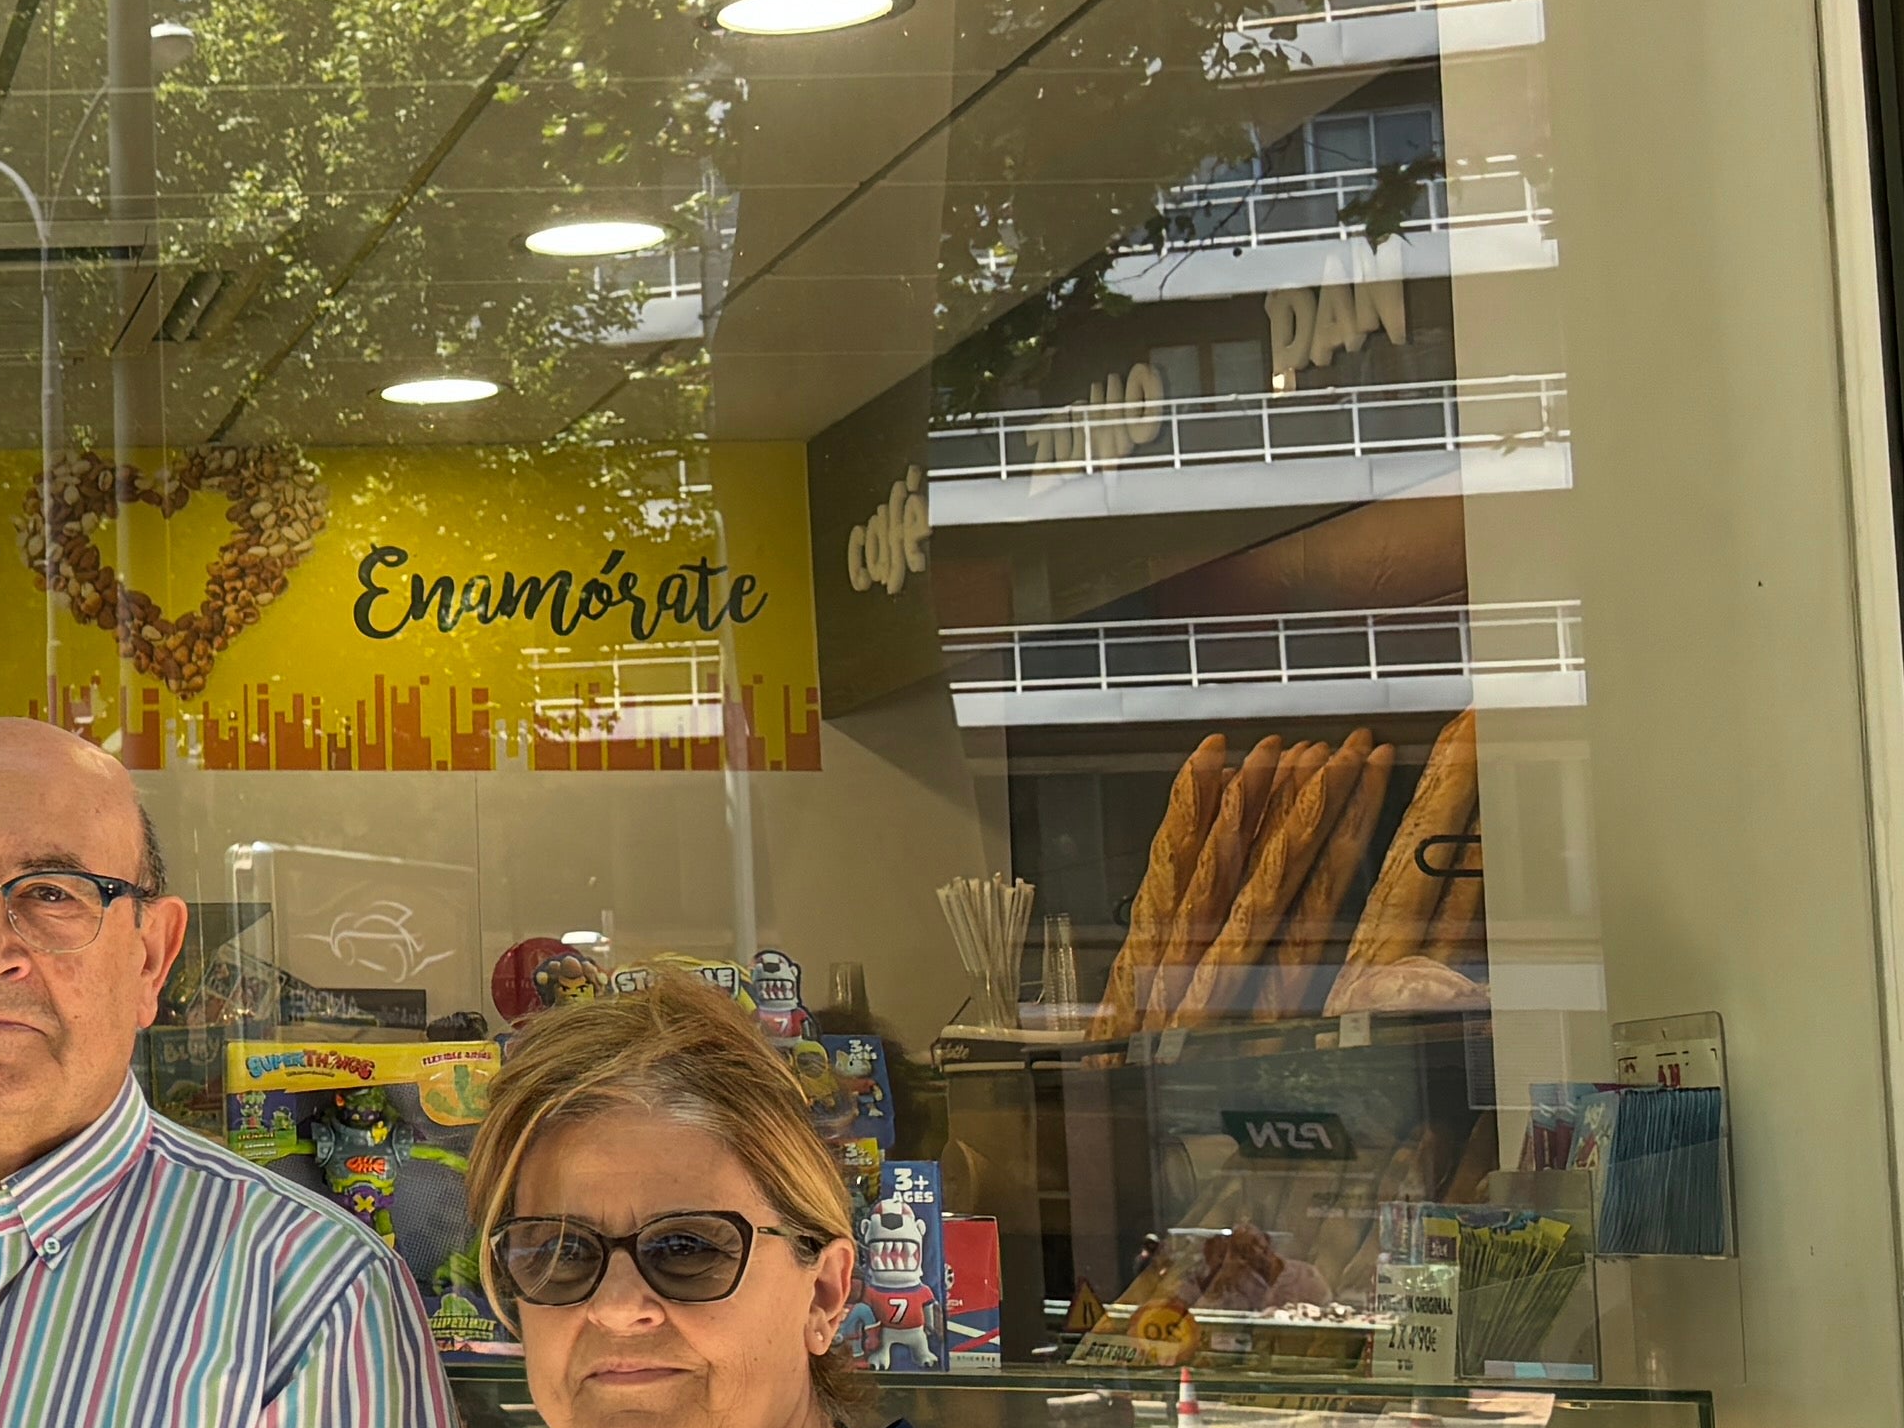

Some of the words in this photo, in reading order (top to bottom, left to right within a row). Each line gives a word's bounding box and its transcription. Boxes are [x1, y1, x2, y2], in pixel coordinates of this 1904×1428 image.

[352, 544, 769, 643] Enamórate
[246, 1048, 376, 1081] SUPERTHINGS
[893, 1167, 930, 1191] 3+
[892, 1190, 934, 1204] AGES
[889, 1299, 909, 1323] 7
